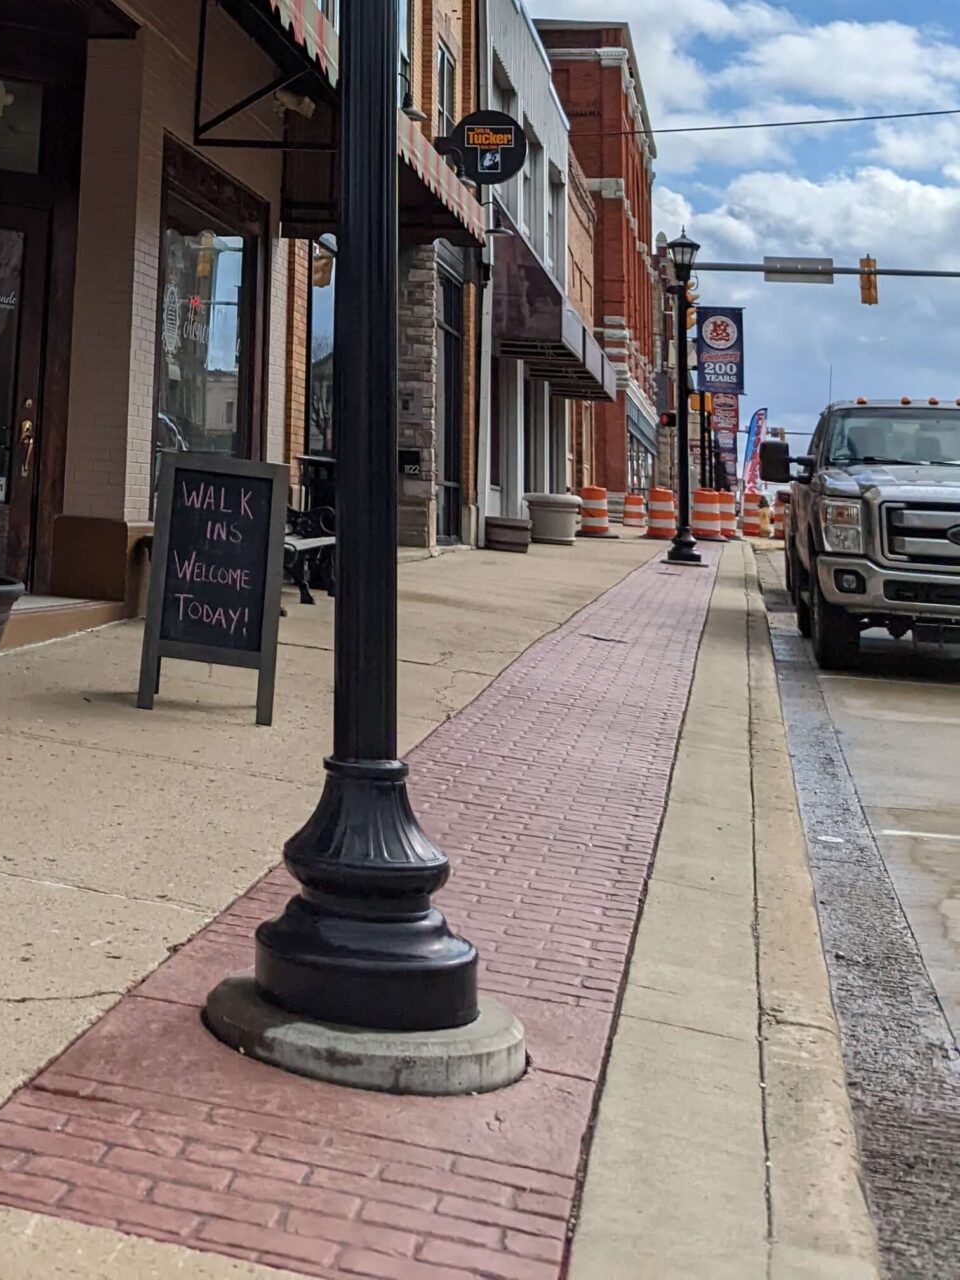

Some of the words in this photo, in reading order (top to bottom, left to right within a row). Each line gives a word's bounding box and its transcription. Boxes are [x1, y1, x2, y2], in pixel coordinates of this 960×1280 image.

[704, 362, 737, 375] 200
[704, 374, 737, 383] YEARS
[183, 481, 254, 519] WALK
[206, 521, 242, 543] INS
[174, 593, 249, 637] TODAY!
